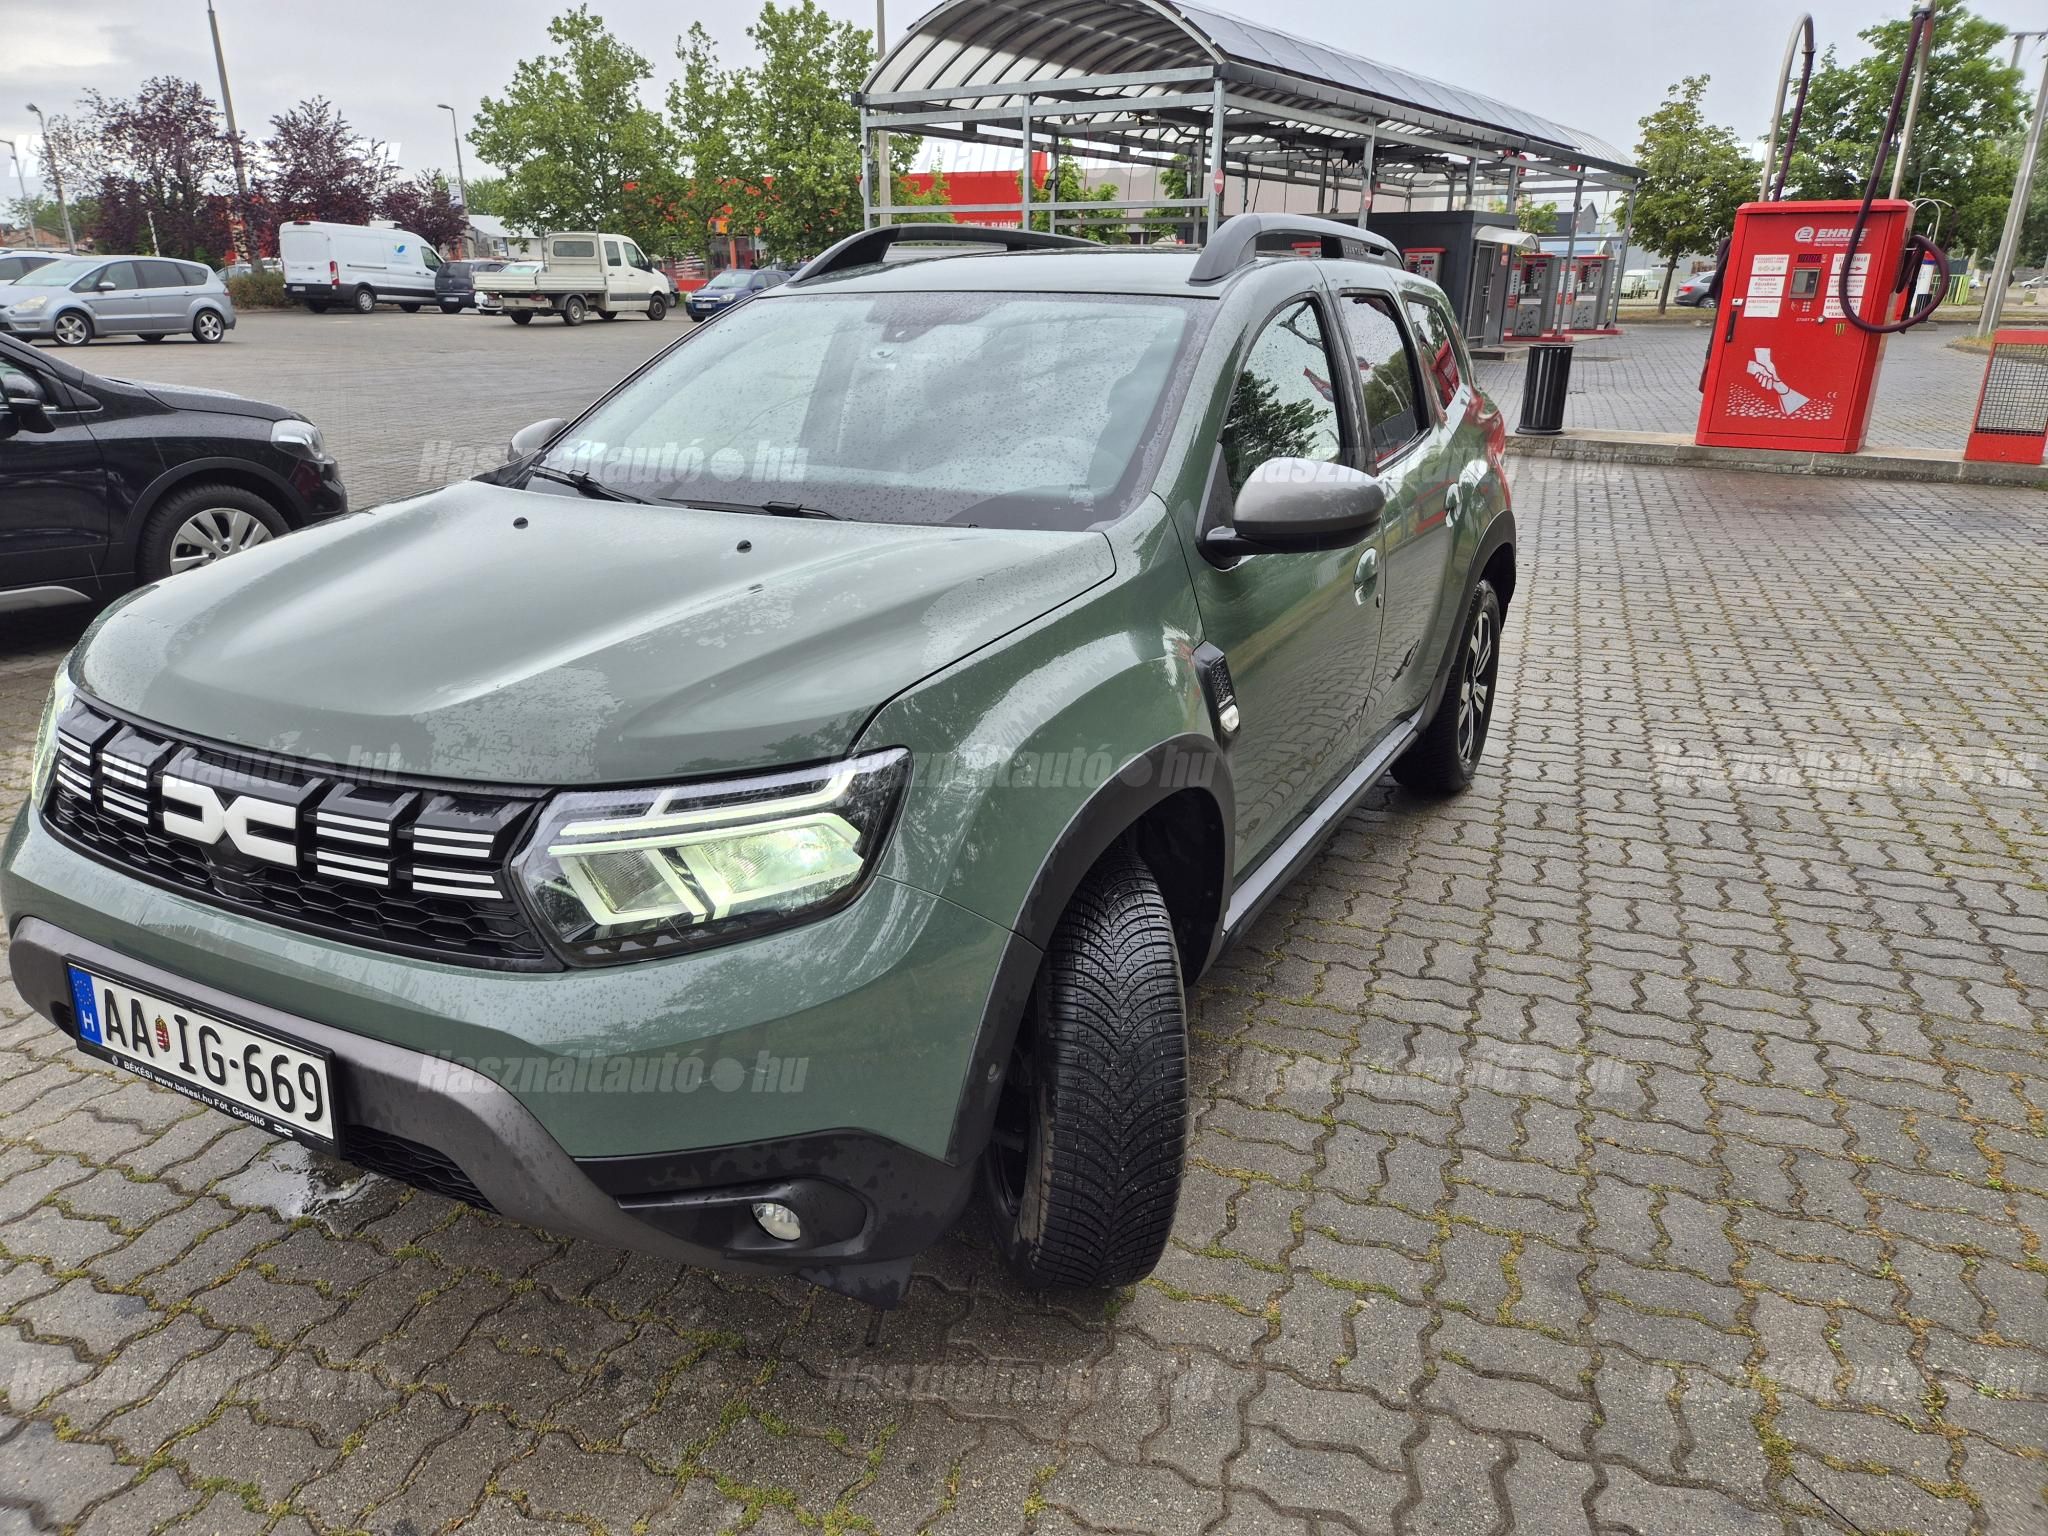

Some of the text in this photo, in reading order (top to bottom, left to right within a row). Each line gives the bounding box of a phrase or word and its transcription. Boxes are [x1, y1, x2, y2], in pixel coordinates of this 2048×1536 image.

[82, 1012, 95, 1032] H
[123, 1060, 153, 1080] BÉKÉSI
[154, 1075, 213, 1105] www.bekesi.hu
